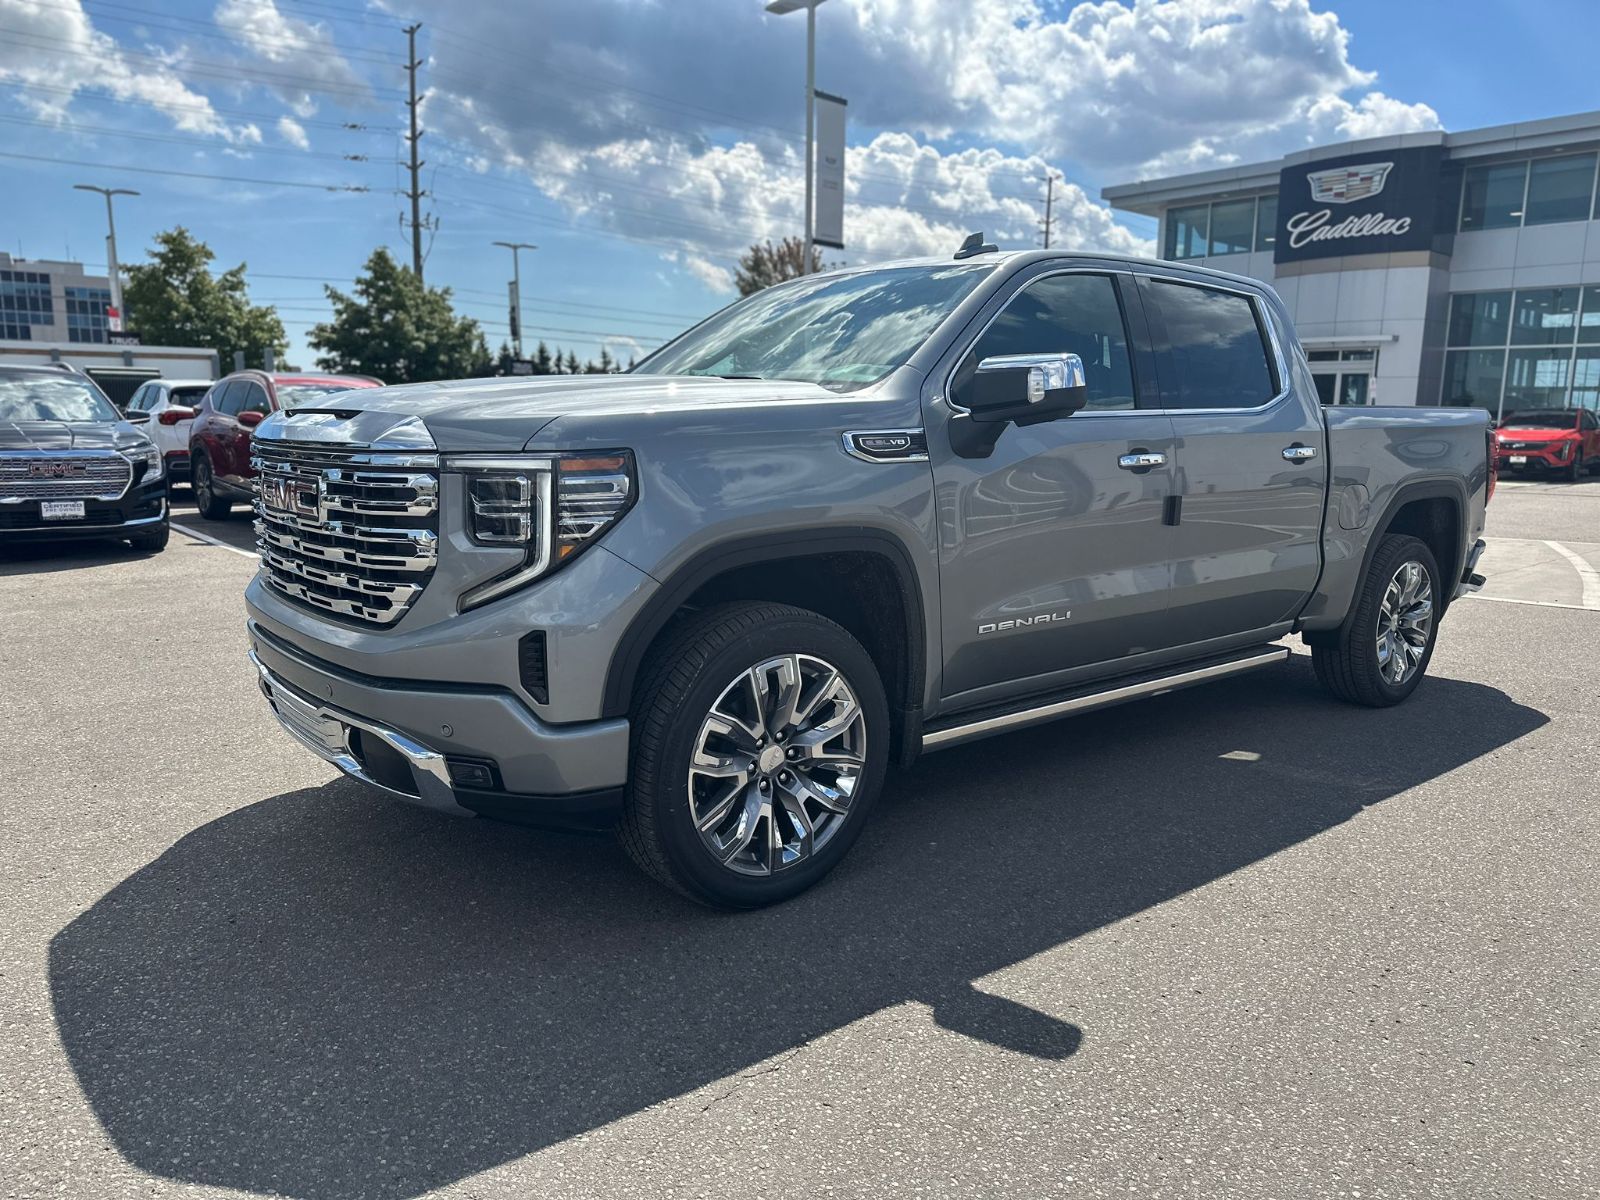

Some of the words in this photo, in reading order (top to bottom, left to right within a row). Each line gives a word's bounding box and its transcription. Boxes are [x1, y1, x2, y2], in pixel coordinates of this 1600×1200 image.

[1286, 209, 1412, 248] Cadillac
[31, 464, 86, 476] GMC
[263, 477, 319, 517] GMC
[978, 610, 1071, 634] DENALI
